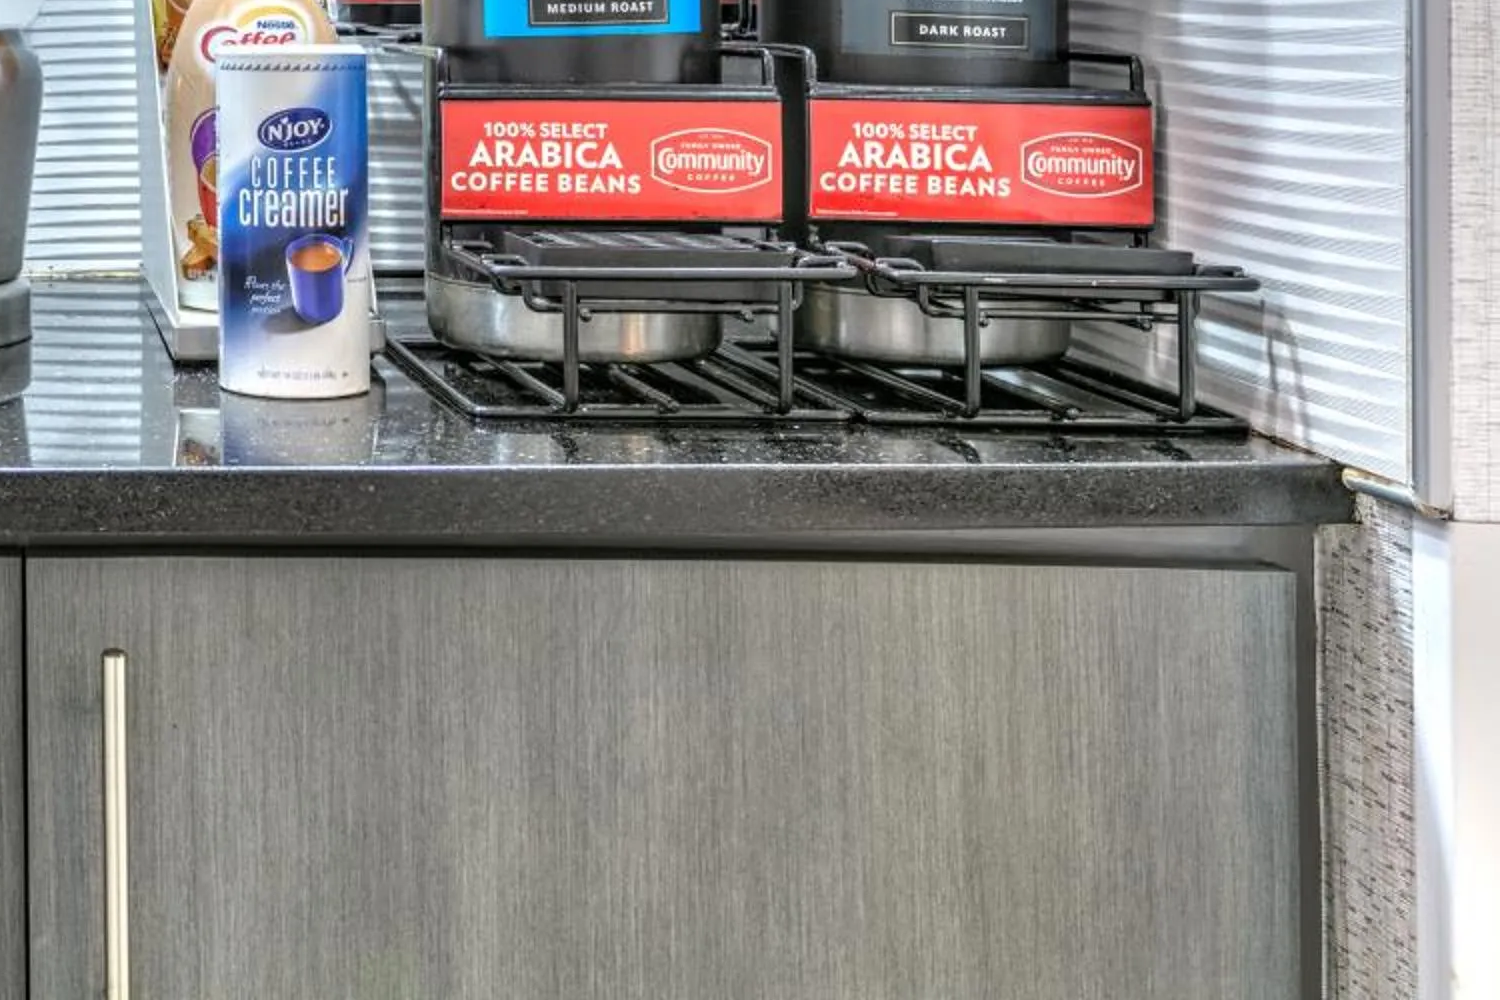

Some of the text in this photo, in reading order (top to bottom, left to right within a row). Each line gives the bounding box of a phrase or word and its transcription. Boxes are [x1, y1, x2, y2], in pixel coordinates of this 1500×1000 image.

[547, 1, 653, 14] MEDIUM ROAST
[919, 24, 1007, 38] DARK ROAST
[484, 121, 608, 140] 100% SELECT
[852, 121, 978, 142] 100% SELECT
[469, 139, 623, 169] ARABICA
[658, 147, 764, 176] Community
[837, 139, 992, 172] ARABICA
[1028, 151, 1135, 181] Community
[251, 156, 336, 189] COFFEE
[451, 172, 641, 195] COFFEE BEANS
[687, 173, 736, 182] COFFEE
[819, 171, 1011, 197] COFFEE BEANS
[1057, 177, 1105, 187] COFFEE
[239, 187, 349, 228] creamer
